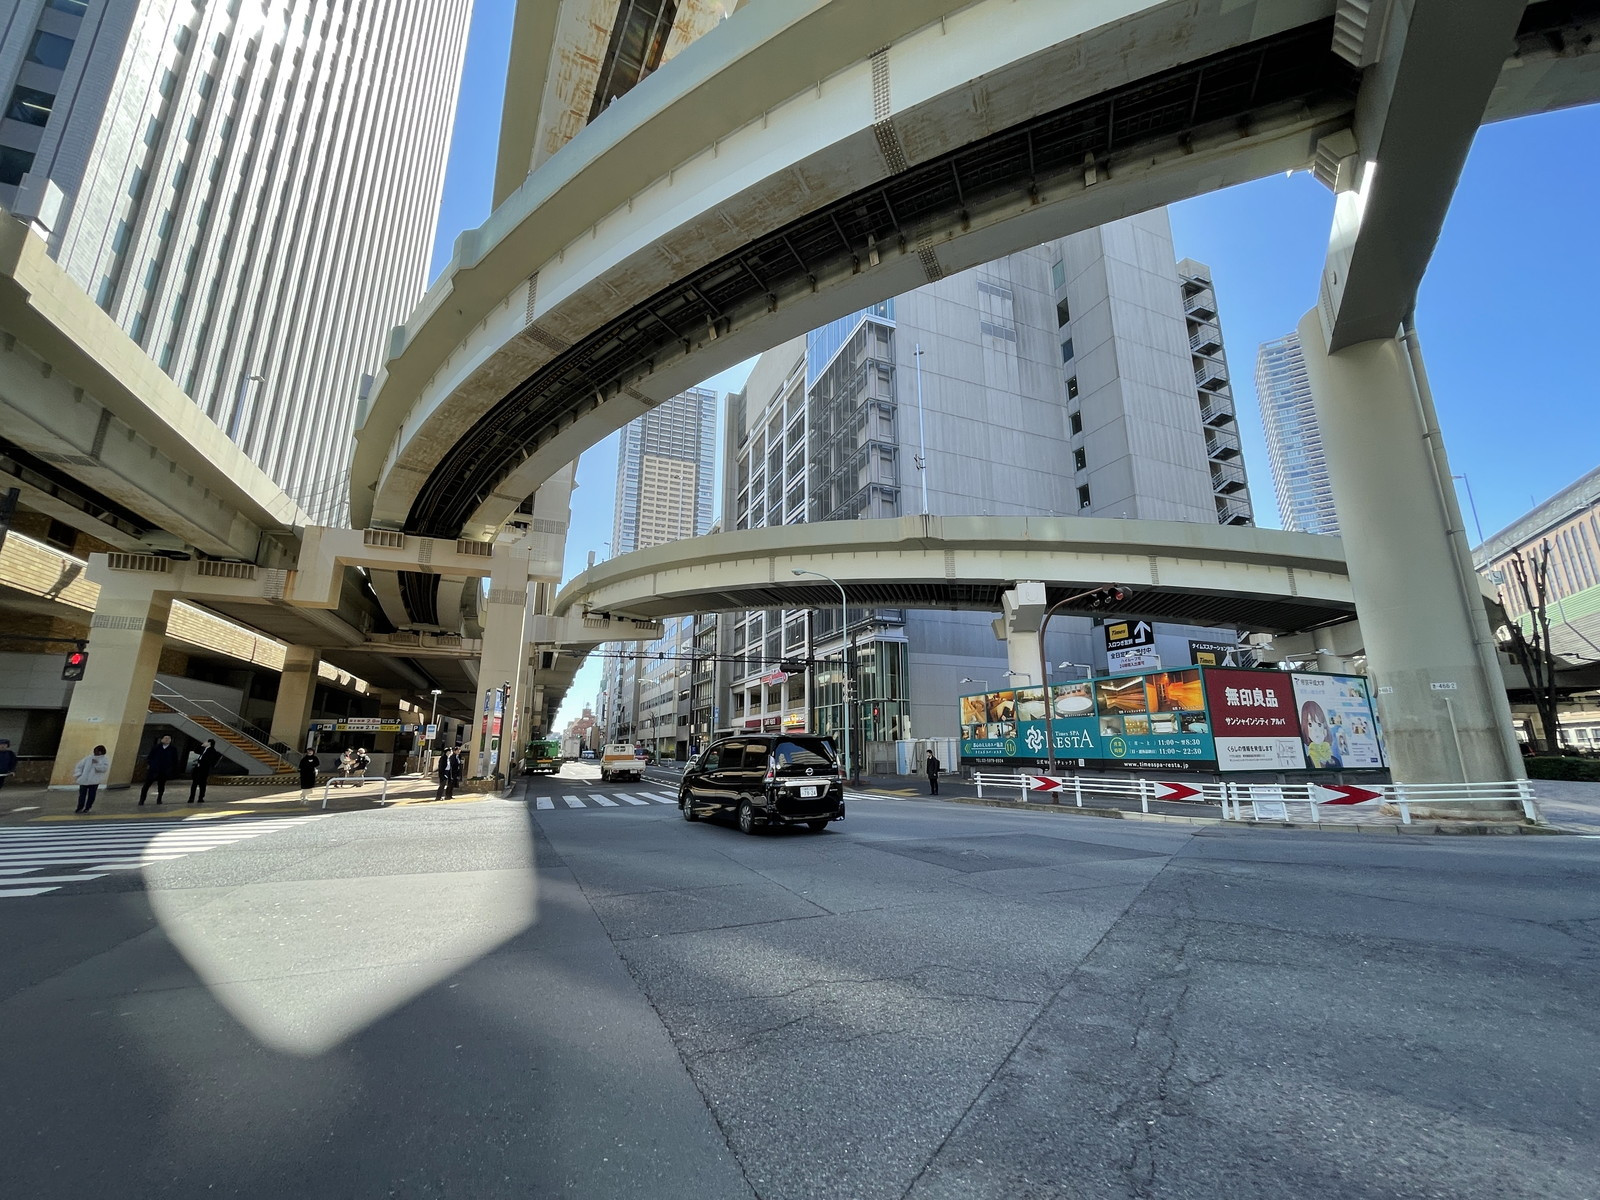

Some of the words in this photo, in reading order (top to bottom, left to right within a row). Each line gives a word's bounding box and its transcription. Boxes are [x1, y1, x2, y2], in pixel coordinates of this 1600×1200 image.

[1225, 686, 1279, 708] 無印良品
[1225, 717, 1269, 726] サンシャインシティ
[1270, 717, 1286, 725] アルパ
[1123, 761, 1189, 769] www.timesspa-resta.jp
